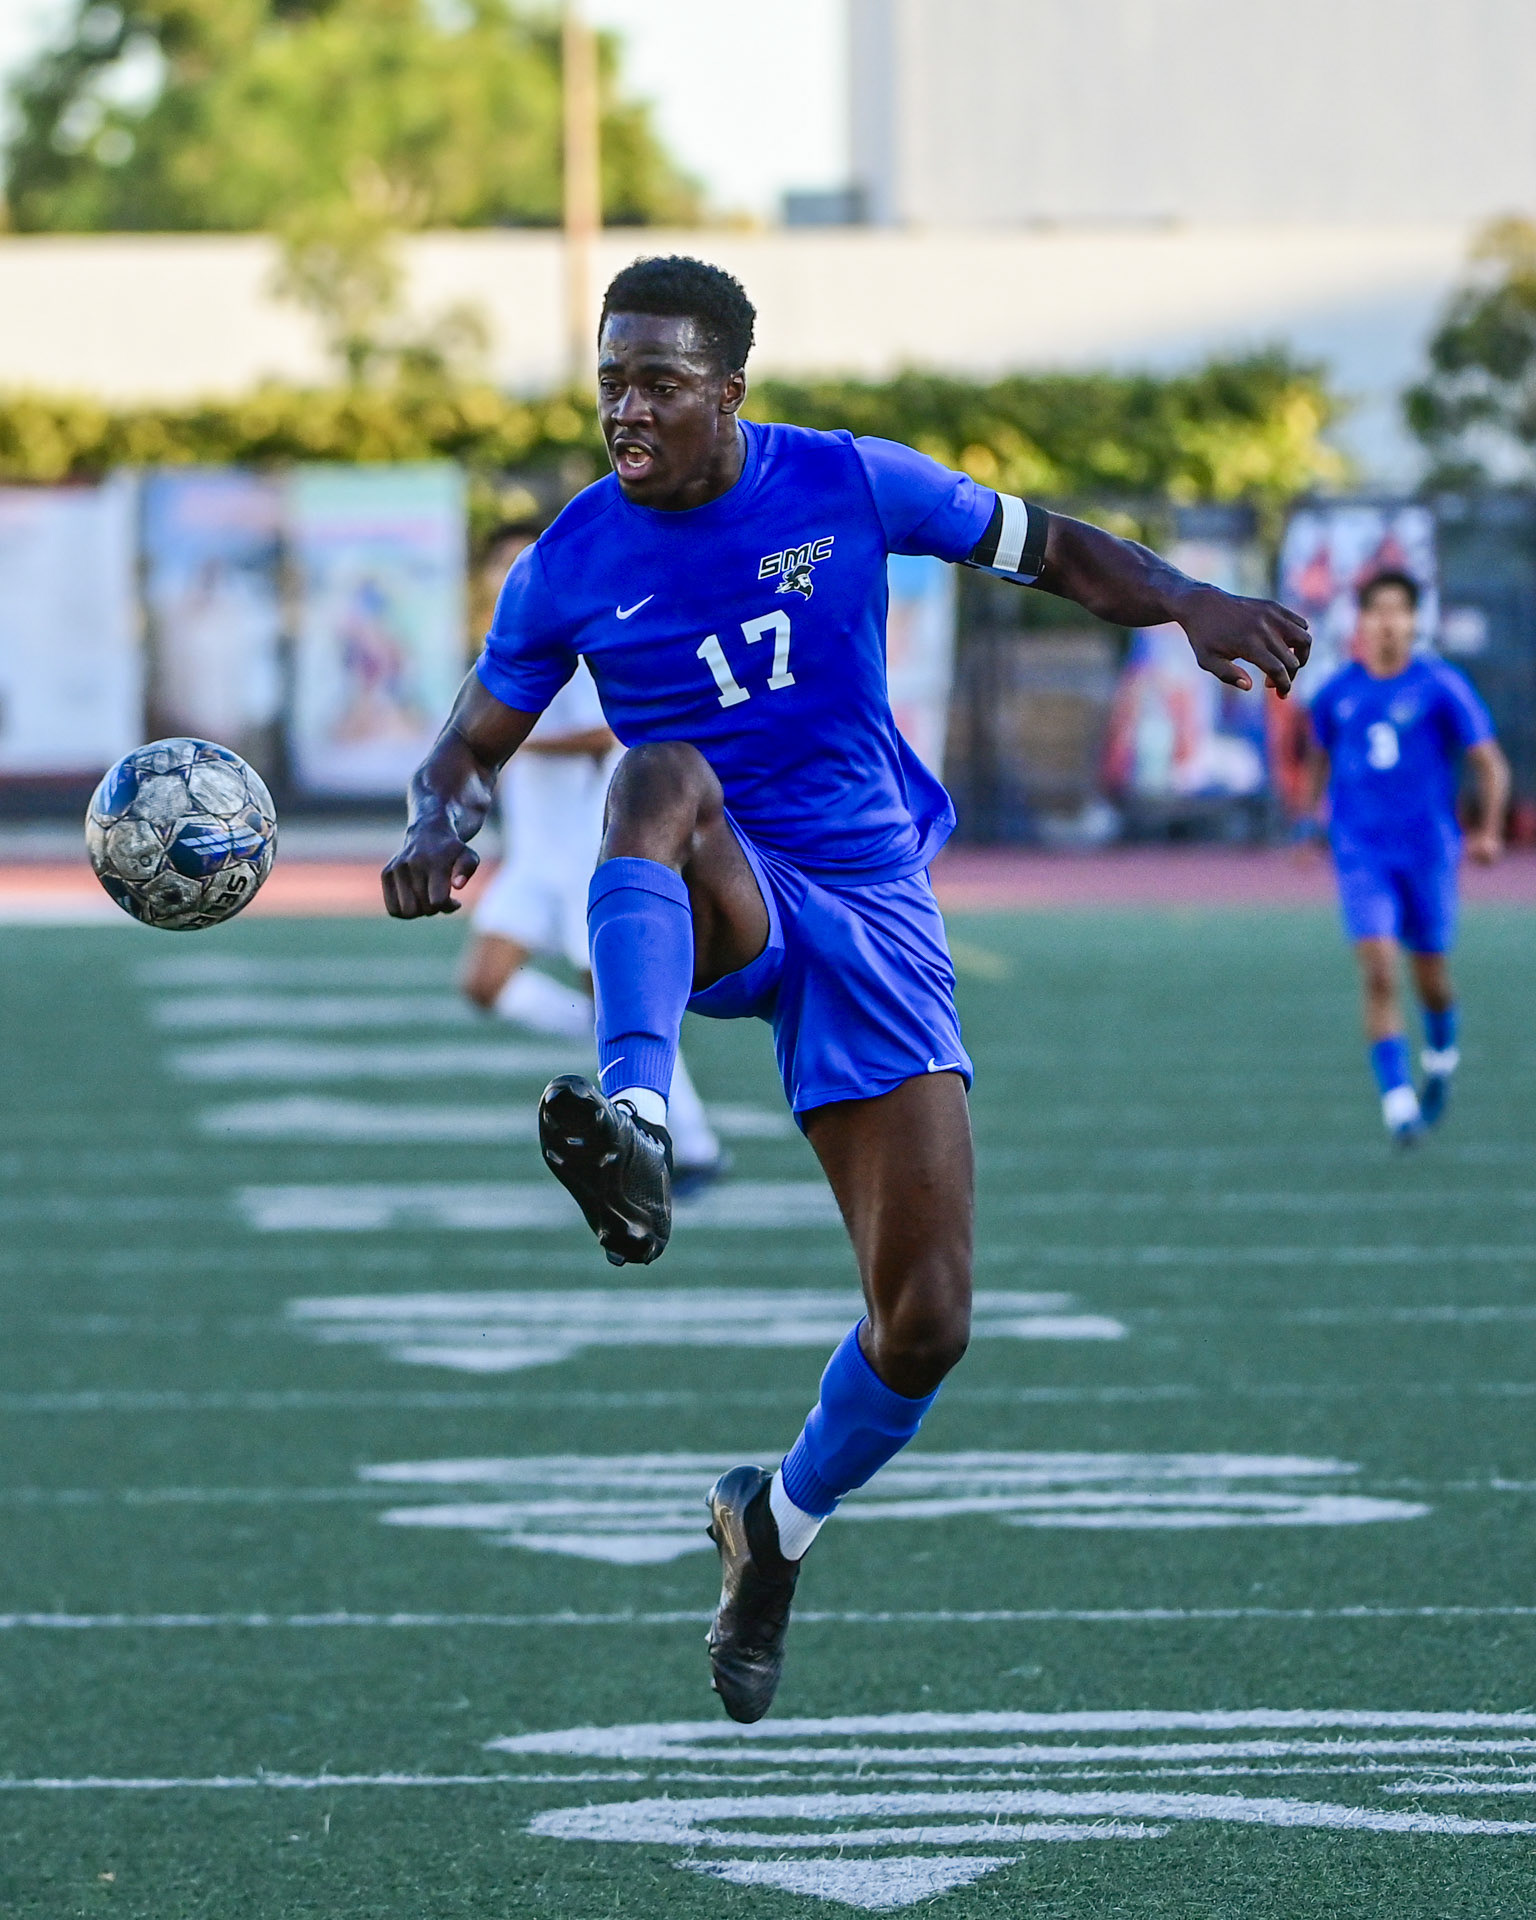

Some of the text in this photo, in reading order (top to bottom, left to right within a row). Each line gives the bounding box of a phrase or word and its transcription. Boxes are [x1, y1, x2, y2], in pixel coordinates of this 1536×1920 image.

[757, 535, 835, 581] SMC
[695, 608, 796, 709] 17
[179, 874, 248, 929] SELE
